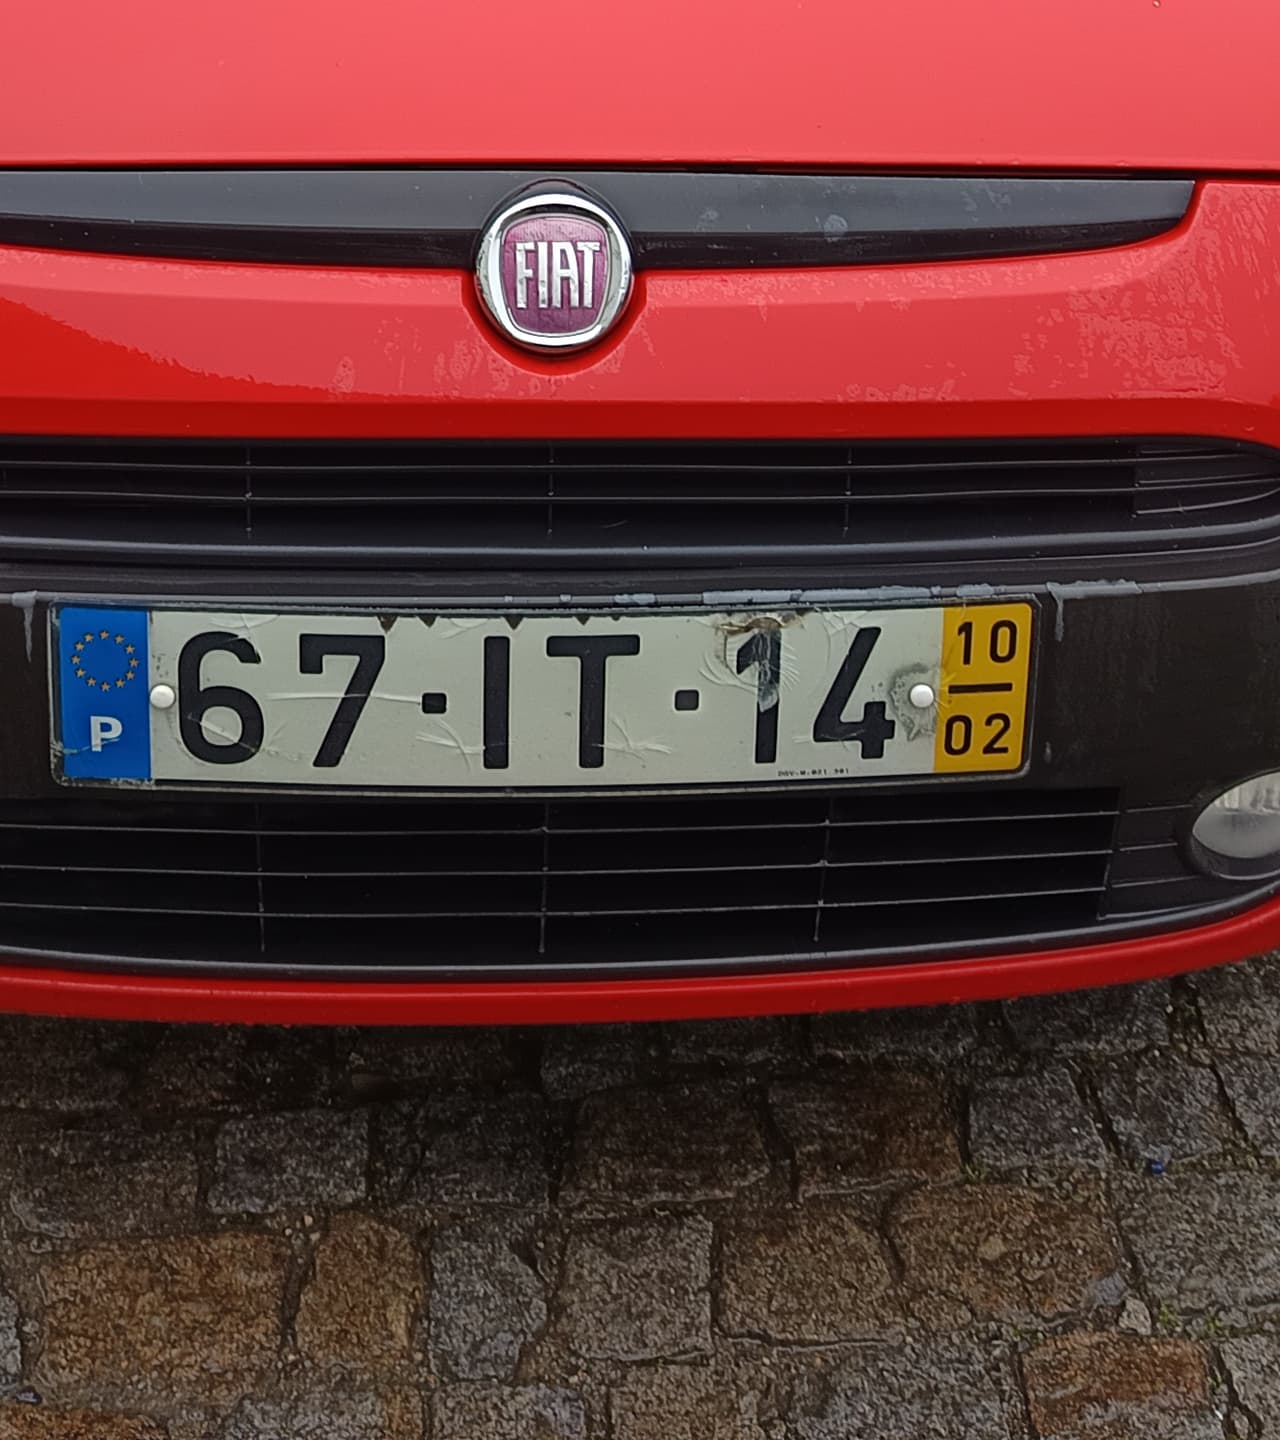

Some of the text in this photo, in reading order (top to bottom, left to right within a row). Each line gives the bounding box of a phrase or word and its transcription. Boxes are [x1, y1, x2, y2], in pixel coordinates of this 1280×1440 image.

[515, 241, 601, 309] FIAT
[957, 620, 1018, 665] 10
[89, 715, 123, 753] P
[944, 713, 1012, 756] 02
